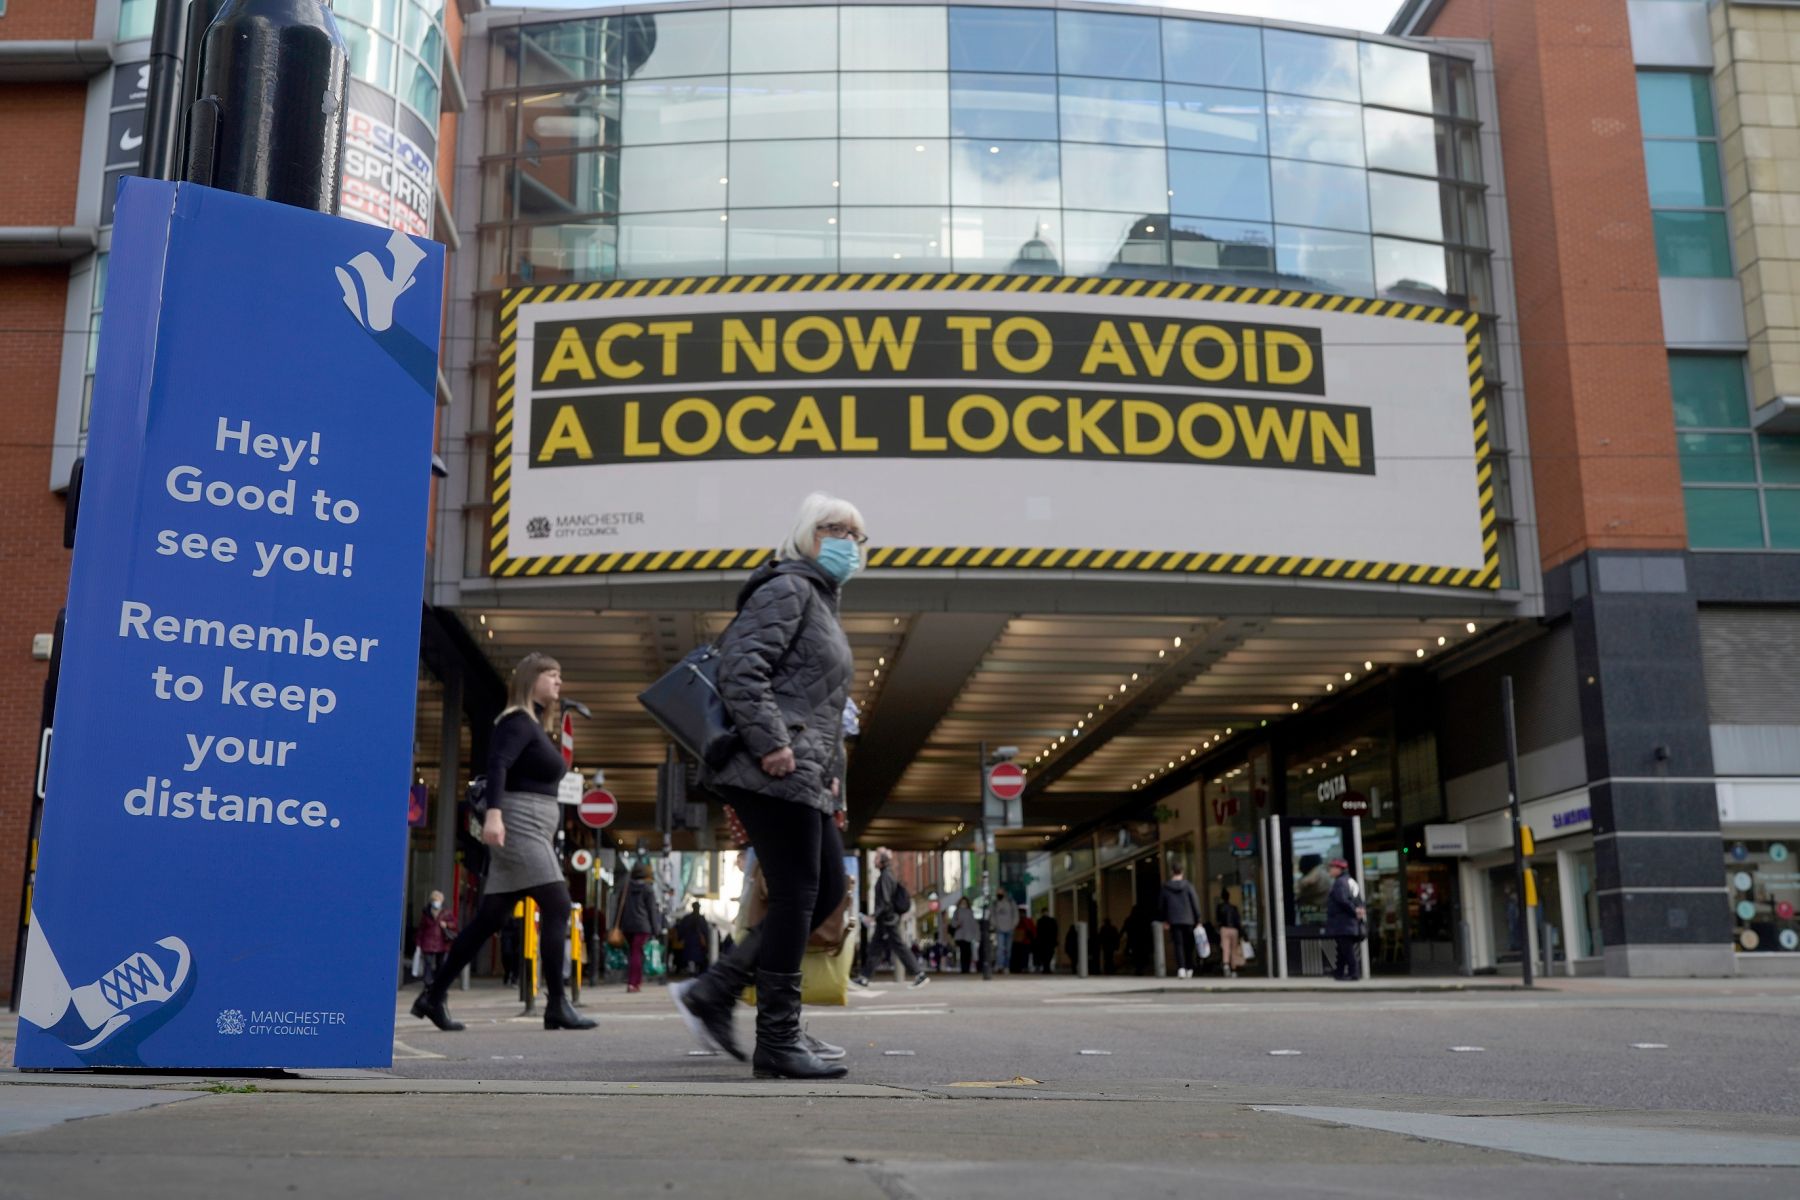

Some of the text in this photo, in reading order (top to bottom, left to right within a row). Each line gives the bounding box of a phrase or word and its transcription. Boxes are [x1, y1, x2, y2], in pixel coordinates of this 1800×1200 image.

[345, 148, 428, 218] SPORTS
[541, 316, 1313, 385] ACT NOW TO AVOID
[215, 416, 321, 472] Hey!
[537, 395, 1361, 467] A LOCAL LOCKDOWN
[166, 465, 360, 524] Good to
[555, 512, 645, 527] MANCHESTER
[155, 529, 354, 578] see you!
[554, 527, 618, 538] CITY COUNCIL
[119, 600, 378, 662] Remember
[152, 666, 337, 724] to keep
[183, 734, 297, 772] your
[124, 776, 340, 828] distance.
[1317, 774, 1346, 802] COSTA
[249, 1025, 319, 1036] CITY COUNCIL
[251, 1010, 346, 1025] MANCHESTER
